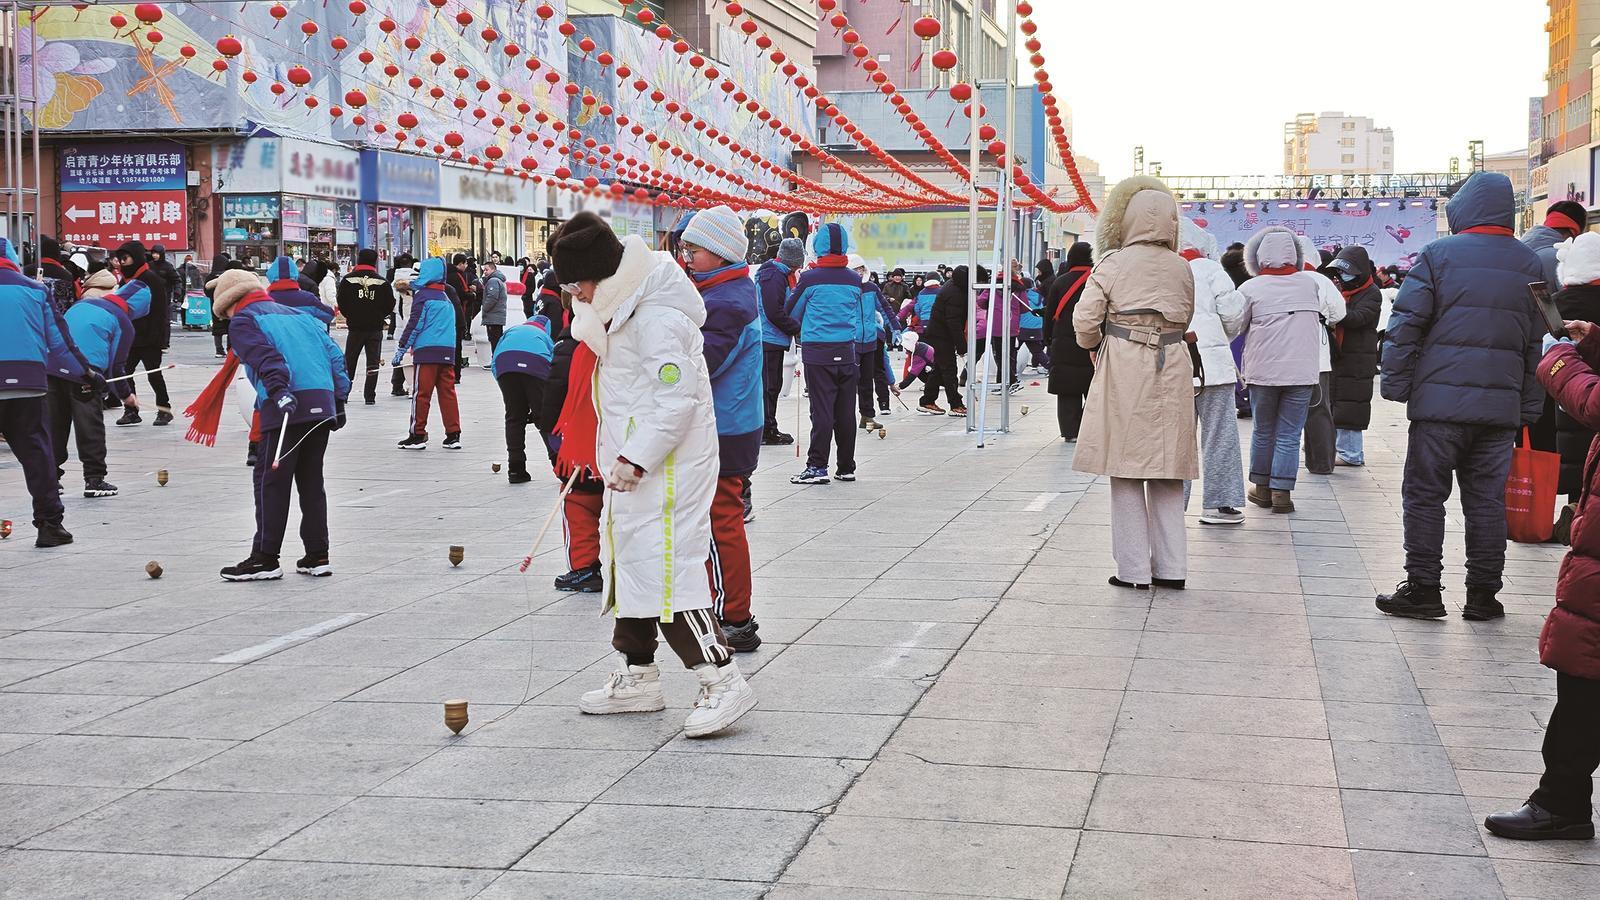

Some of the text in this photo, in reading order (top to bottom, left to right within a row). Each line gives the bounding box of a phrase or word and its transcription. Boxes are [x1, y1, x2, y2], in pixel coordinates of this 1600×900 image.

[65, 153, 181, 168] 启育青少年体育俱乐部
[122, 168, 148, 176] 高考体育
[150, 167, 177, 176] 中考体育
[99, 200, 181, 224] 围炉涮串
